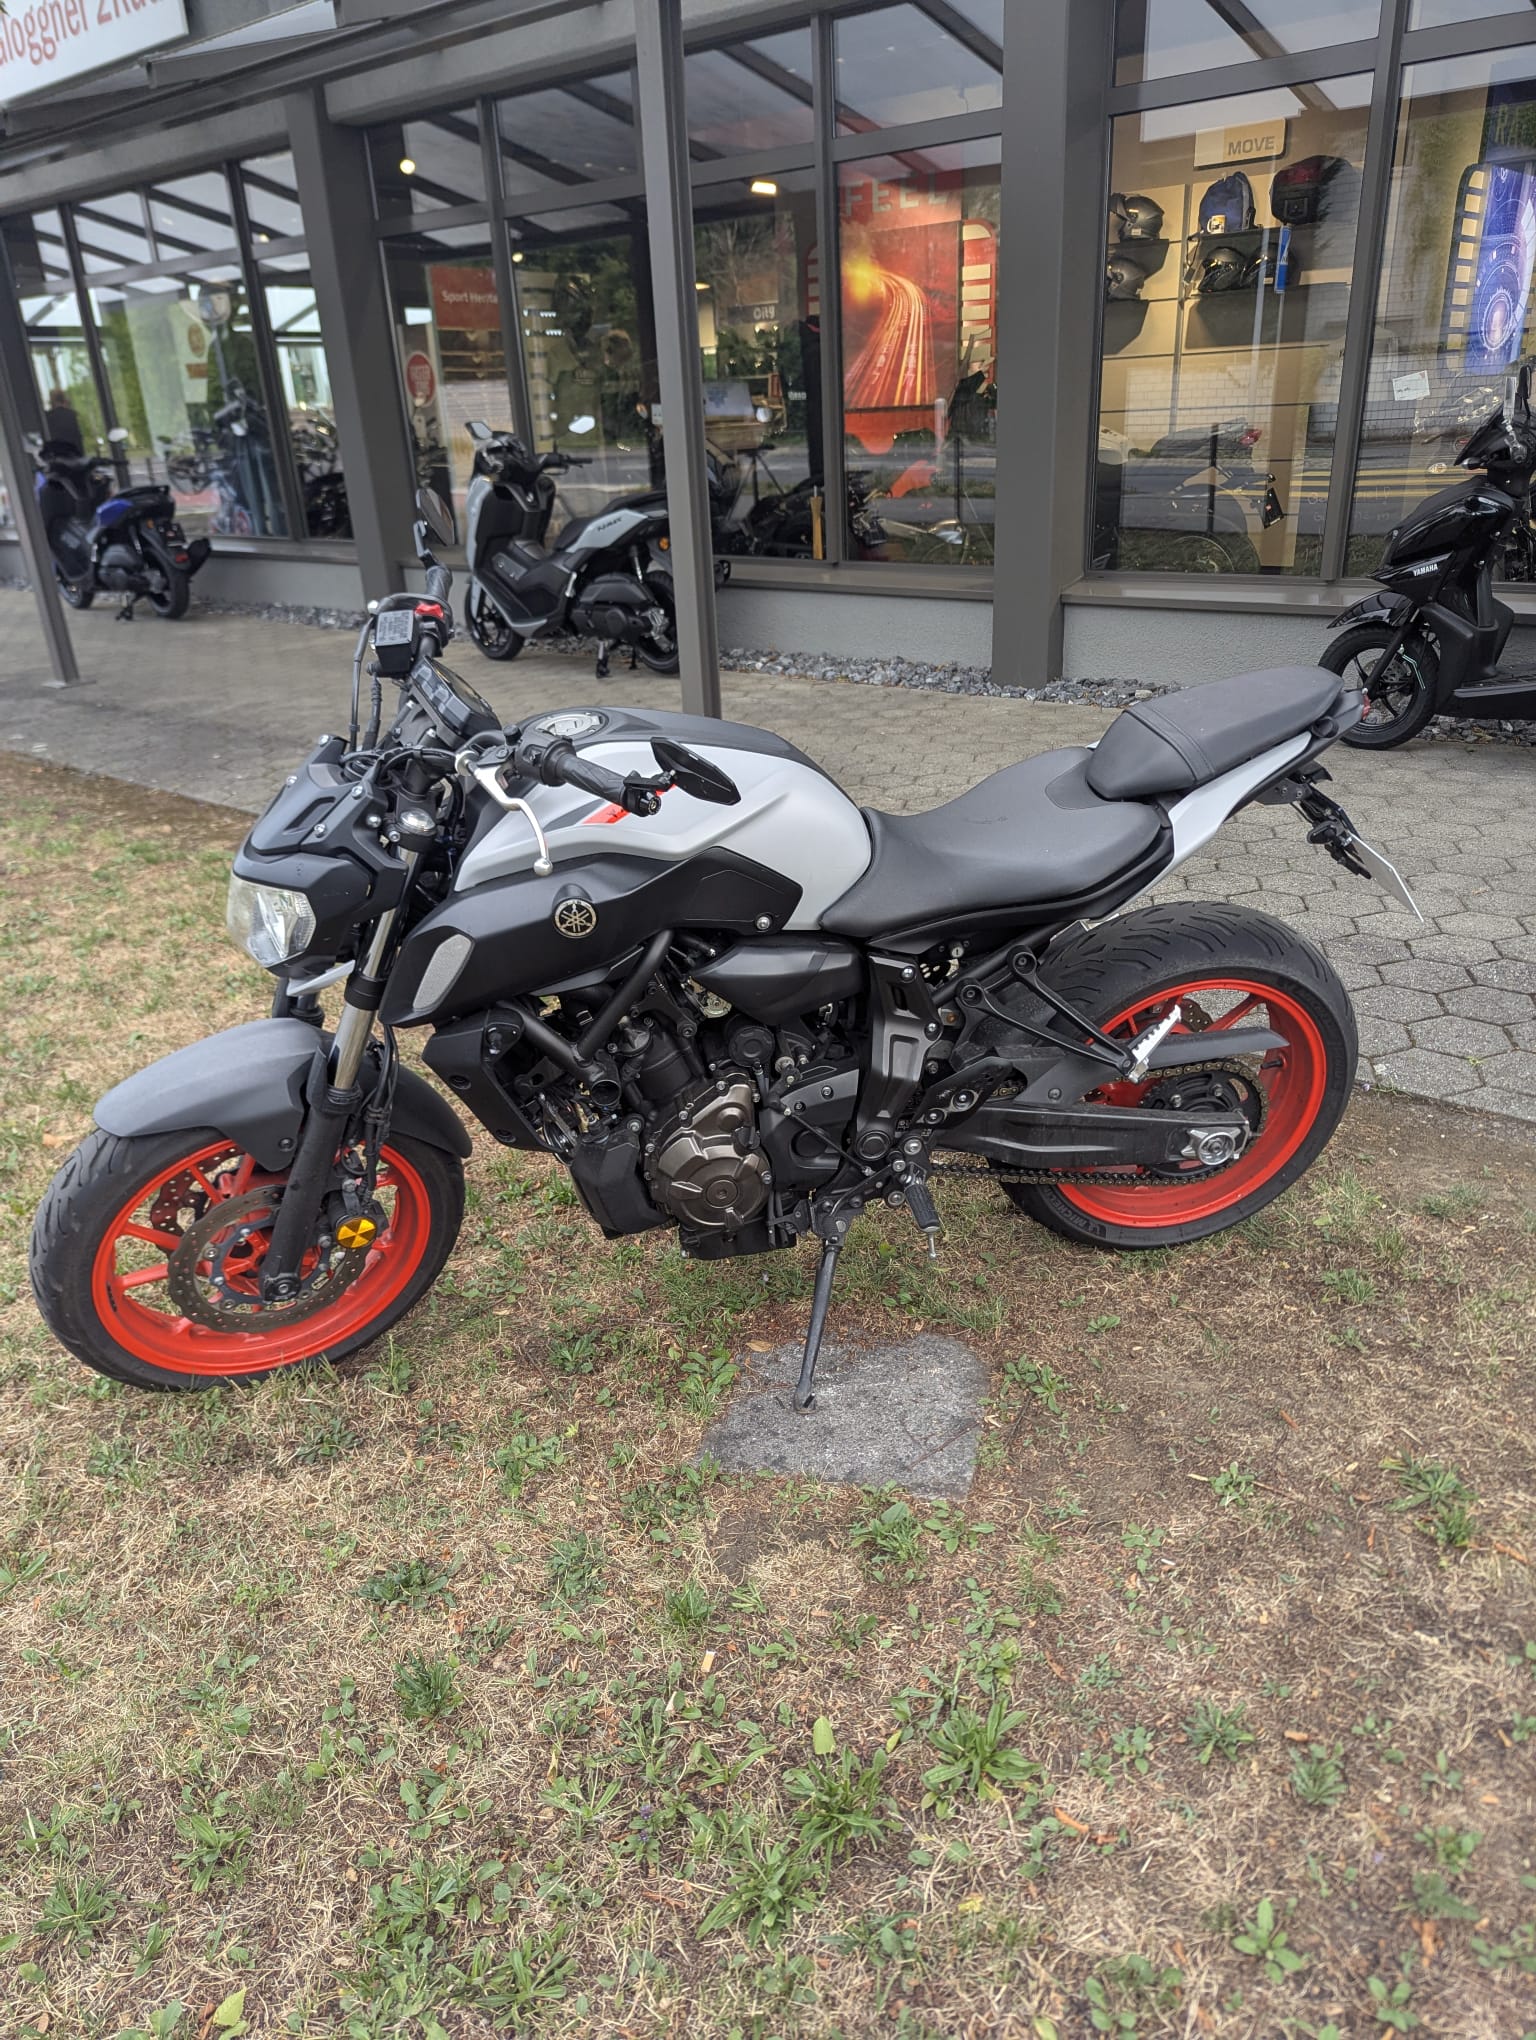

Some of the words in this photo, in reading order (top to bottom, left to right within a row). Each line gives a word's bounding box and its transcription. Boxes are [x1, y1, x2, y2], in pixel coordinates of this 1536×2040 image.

[1228, 135, 1275, 156] MOVE
[844, 172, 948, 217] FEEL
[441, 290, 469, 304] Sport
[1412, 563, 1439, 577] YAMAHA
